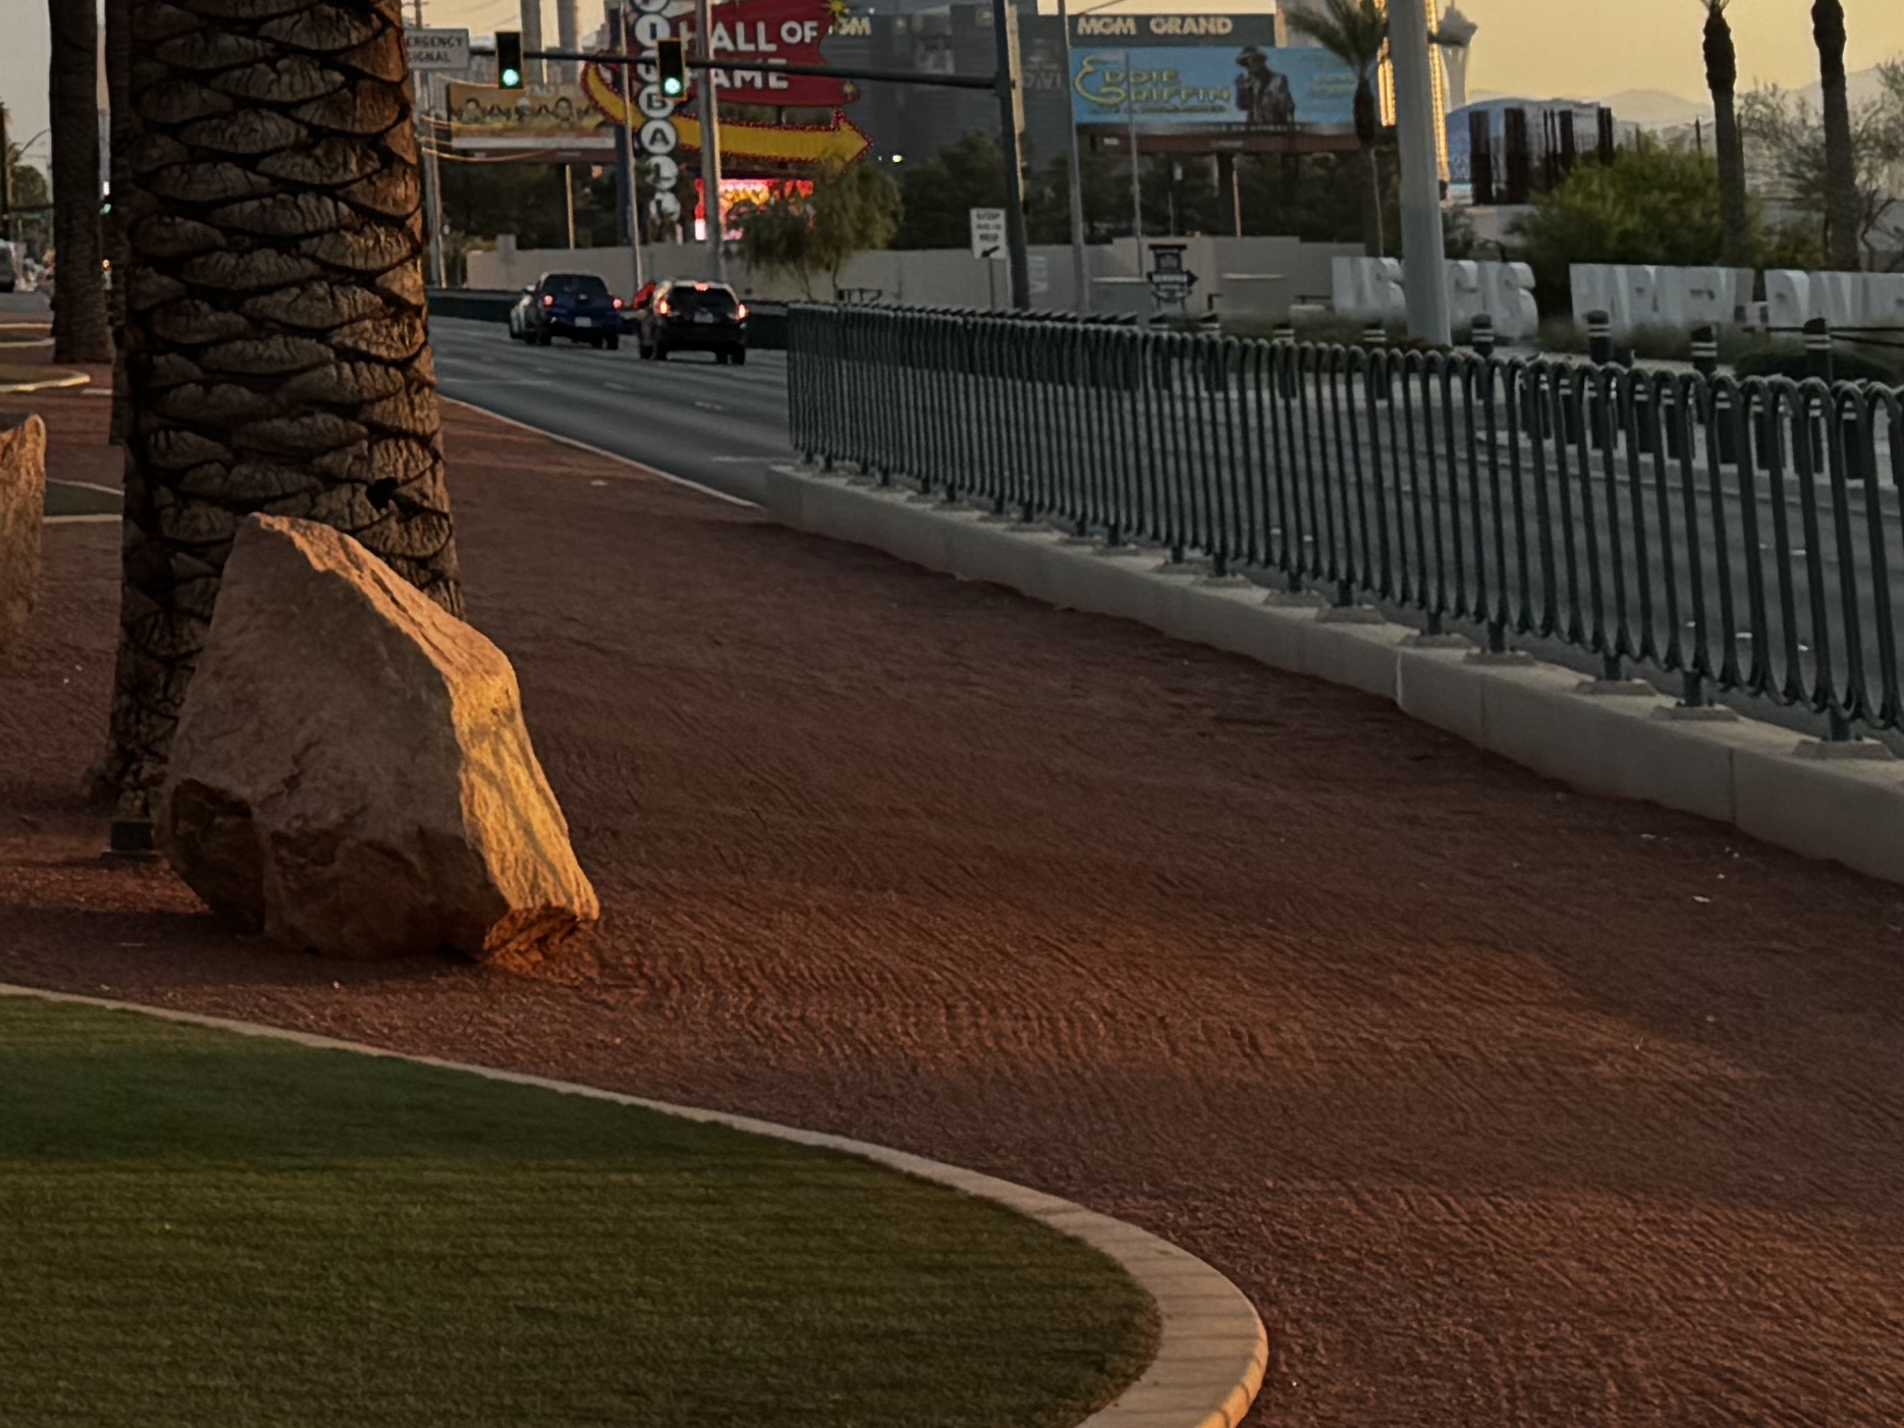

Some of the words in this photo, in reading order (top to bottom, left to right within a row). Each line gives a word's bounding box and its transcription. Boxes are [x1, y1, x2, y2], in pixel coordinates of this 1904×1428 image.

[679, 21, 777, 53] HALL
[780, 20, 819, 44] OF
[1077, 17, 1136, 35] MGM
[1149, 17, 1233, 35] GRAND
